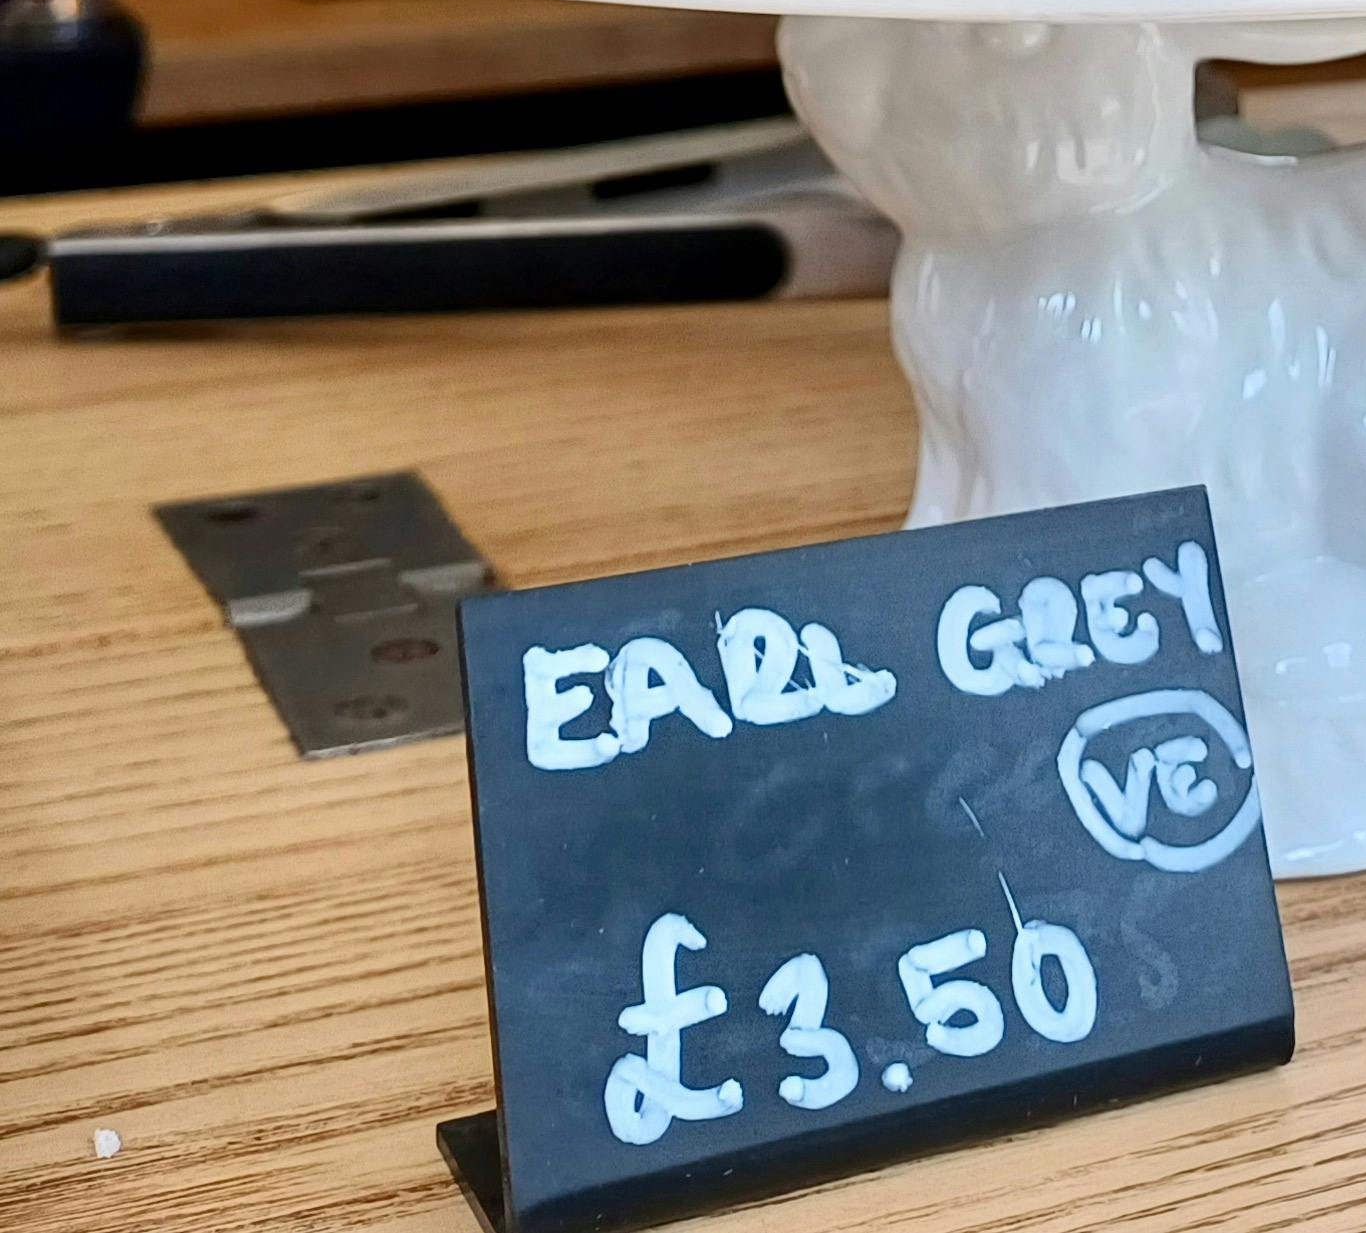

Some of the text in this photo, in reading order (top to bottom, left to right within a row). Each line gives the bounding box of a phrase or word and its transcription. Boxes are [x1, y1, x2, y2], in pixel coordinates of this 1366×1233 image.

[522, 540, 1223, 771] EARL GREY
[1080, 736, 1218, 839] VE
[604, 912, 1098, 1145] £3.50
